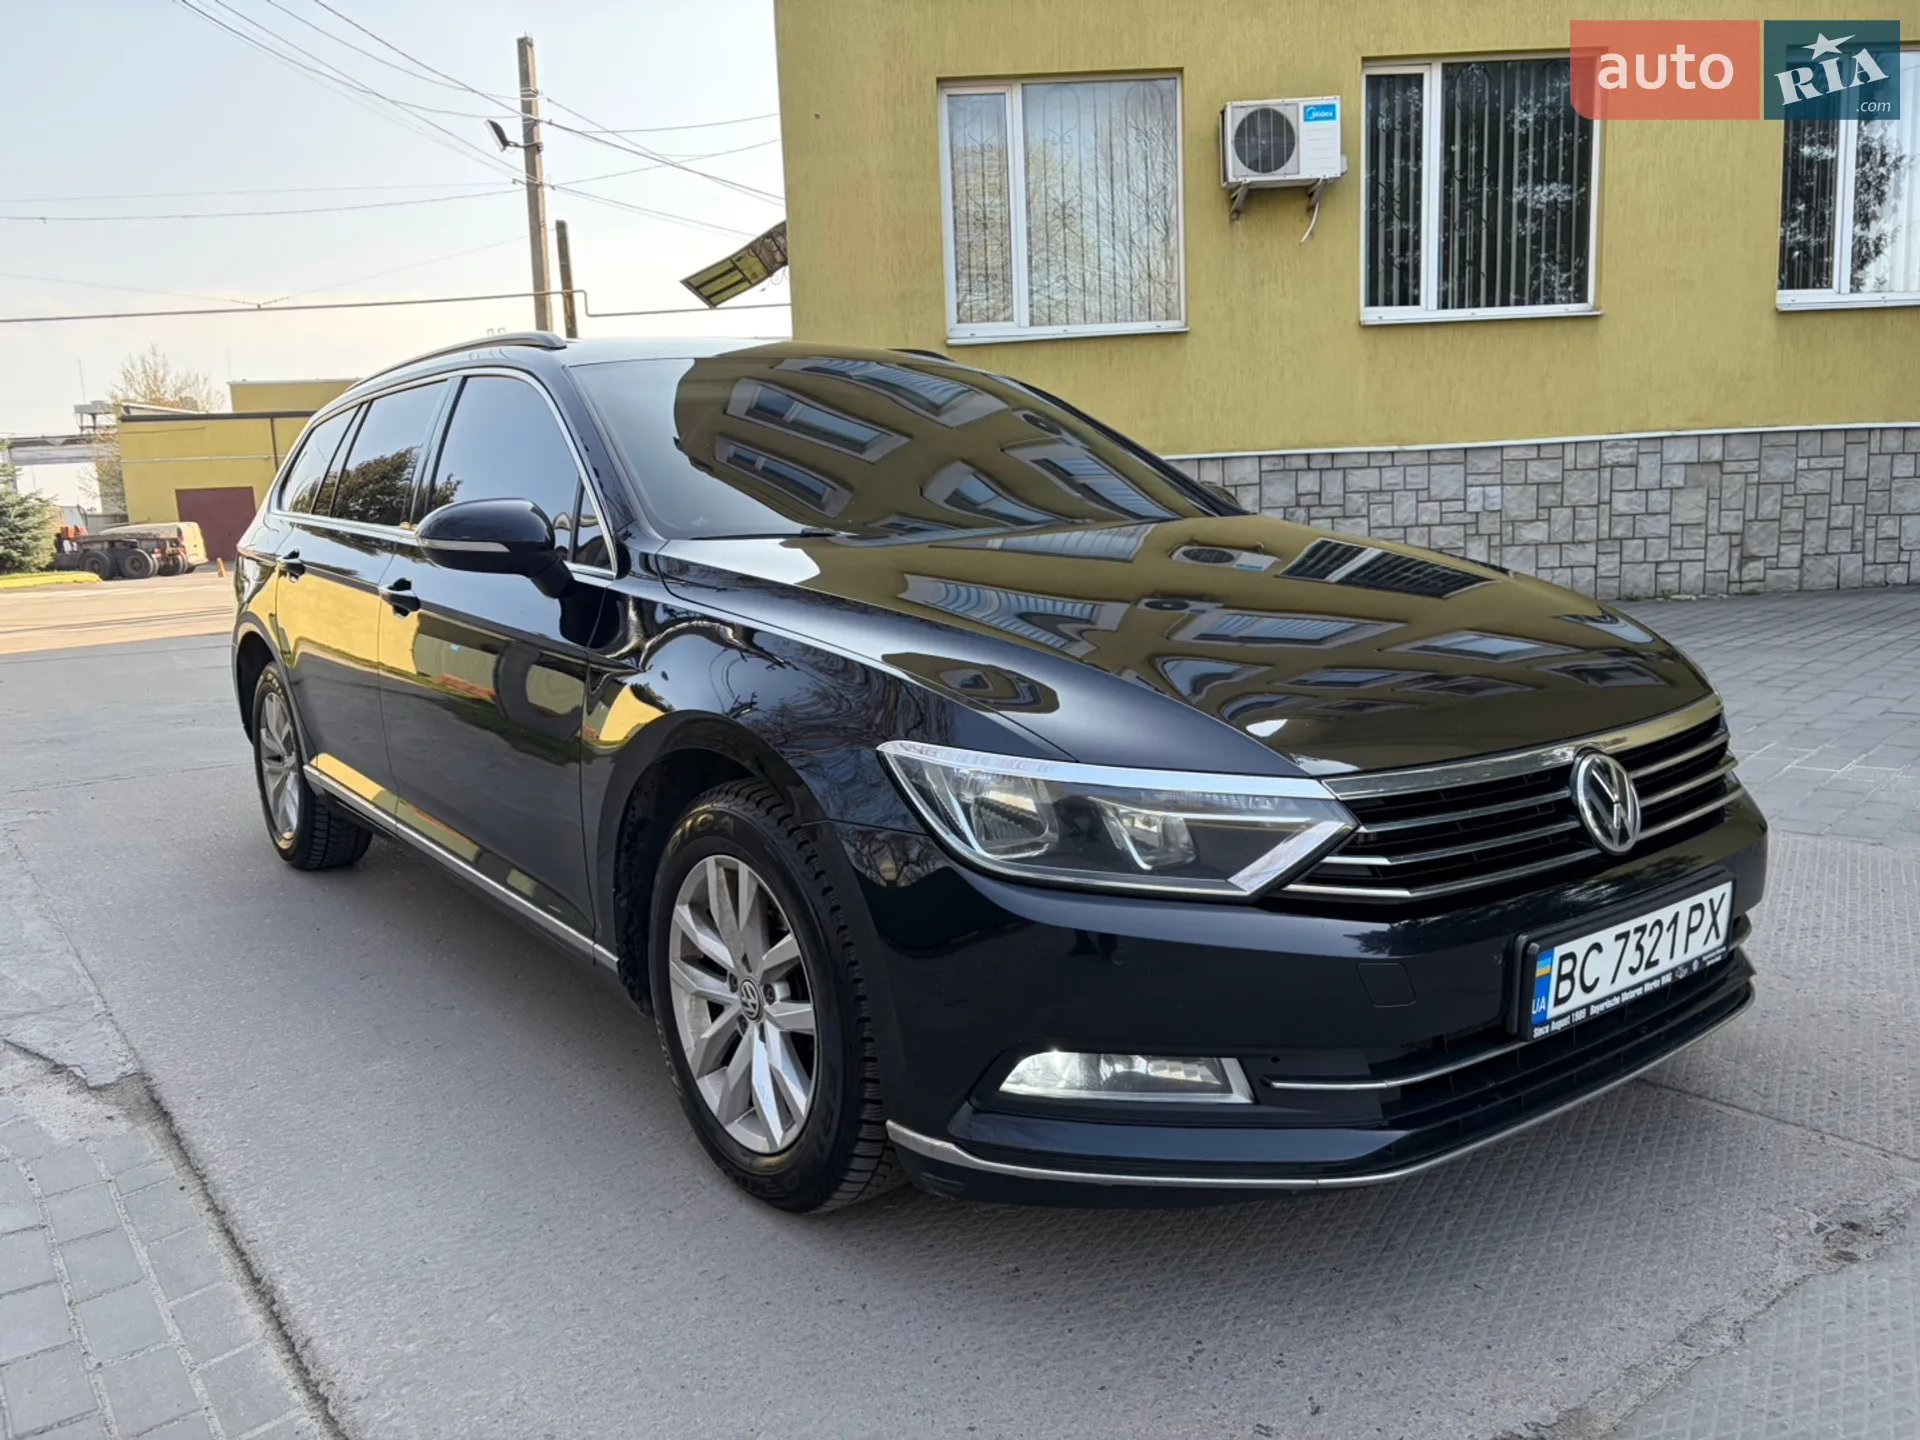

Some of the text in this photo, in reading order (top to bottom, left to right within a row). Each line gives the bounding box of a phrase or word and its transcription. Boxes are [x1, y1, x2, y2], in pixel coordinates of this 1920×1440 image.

[1553, 892, 1726, 1008] BC 7321 PX
[1532, 996, 1546, 1014] UA
